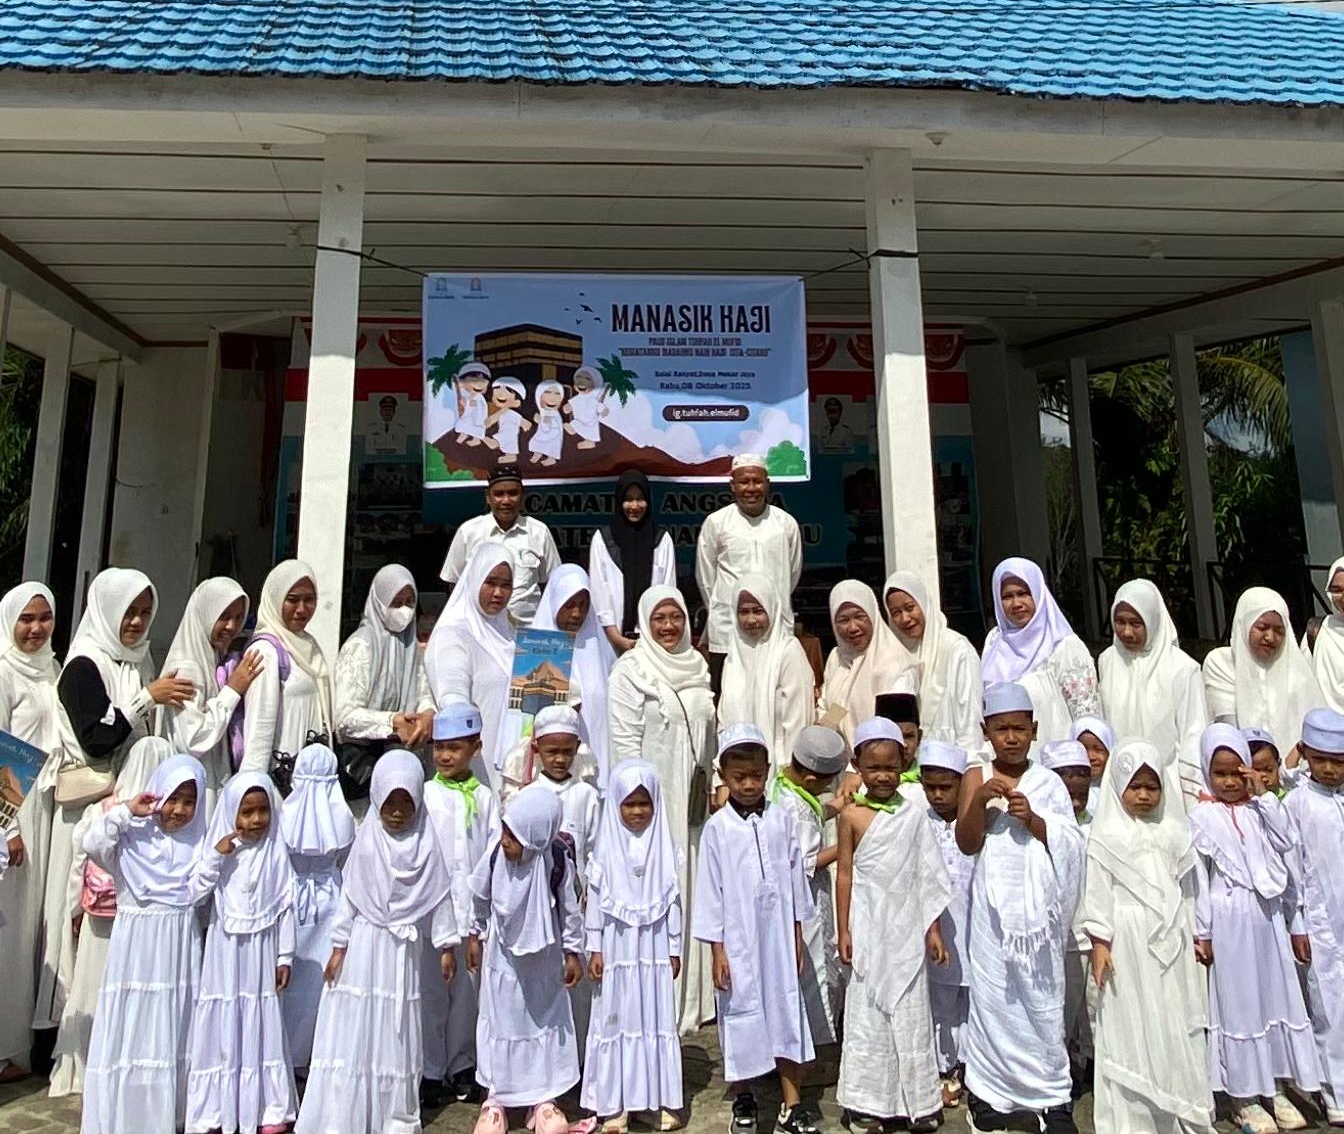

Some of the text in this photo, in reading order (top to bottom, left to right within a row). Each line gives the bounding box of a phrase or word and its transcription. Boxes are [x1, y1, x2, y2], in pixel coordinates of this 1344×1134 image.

[611, 303, 772, 334] MANASIK HAJI
[695, 382, 728, 390] Oktober
[729, 382, 752, 390] 2025
[523, 492, 786, 514] CAMAT ANGSA
